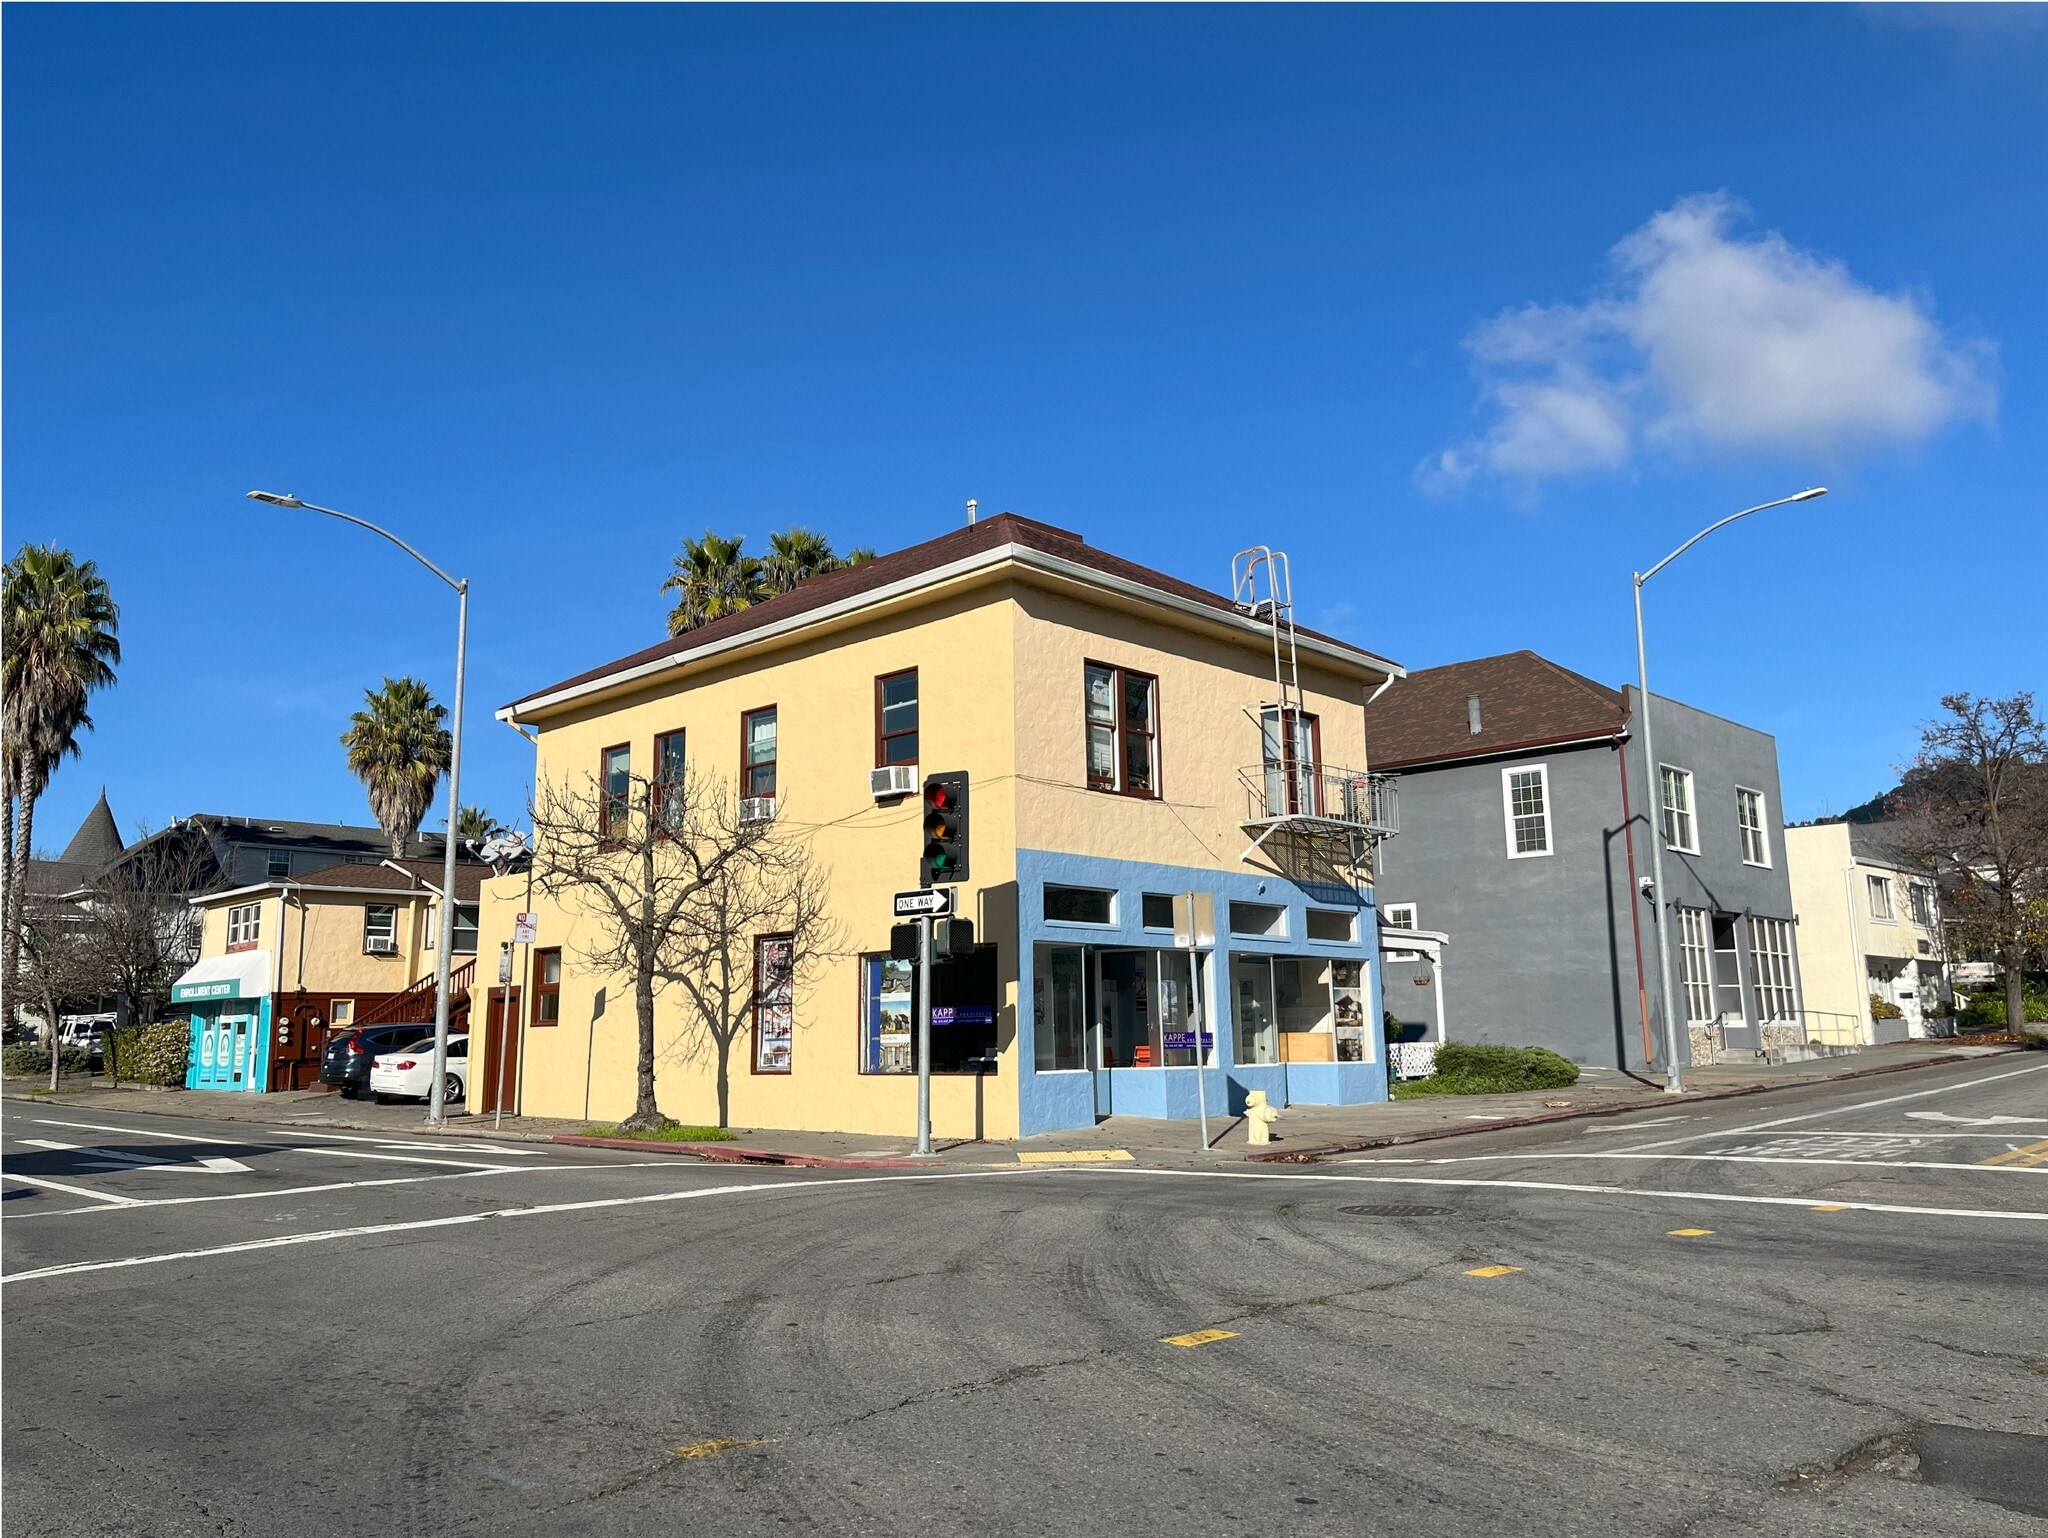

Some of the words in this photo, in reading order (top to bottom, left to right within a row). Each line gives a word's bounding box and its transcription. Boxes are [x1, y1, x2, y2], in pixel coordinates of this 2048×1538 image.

[898, 898, 914, 910] ONE
[918, 896, 934, 907] WAY
[180, 985, 211, 998] ENROLLMENT
[211, 984, 231, 995] CENTER
[1163, 1033, 1186, 1042] KAPPE
